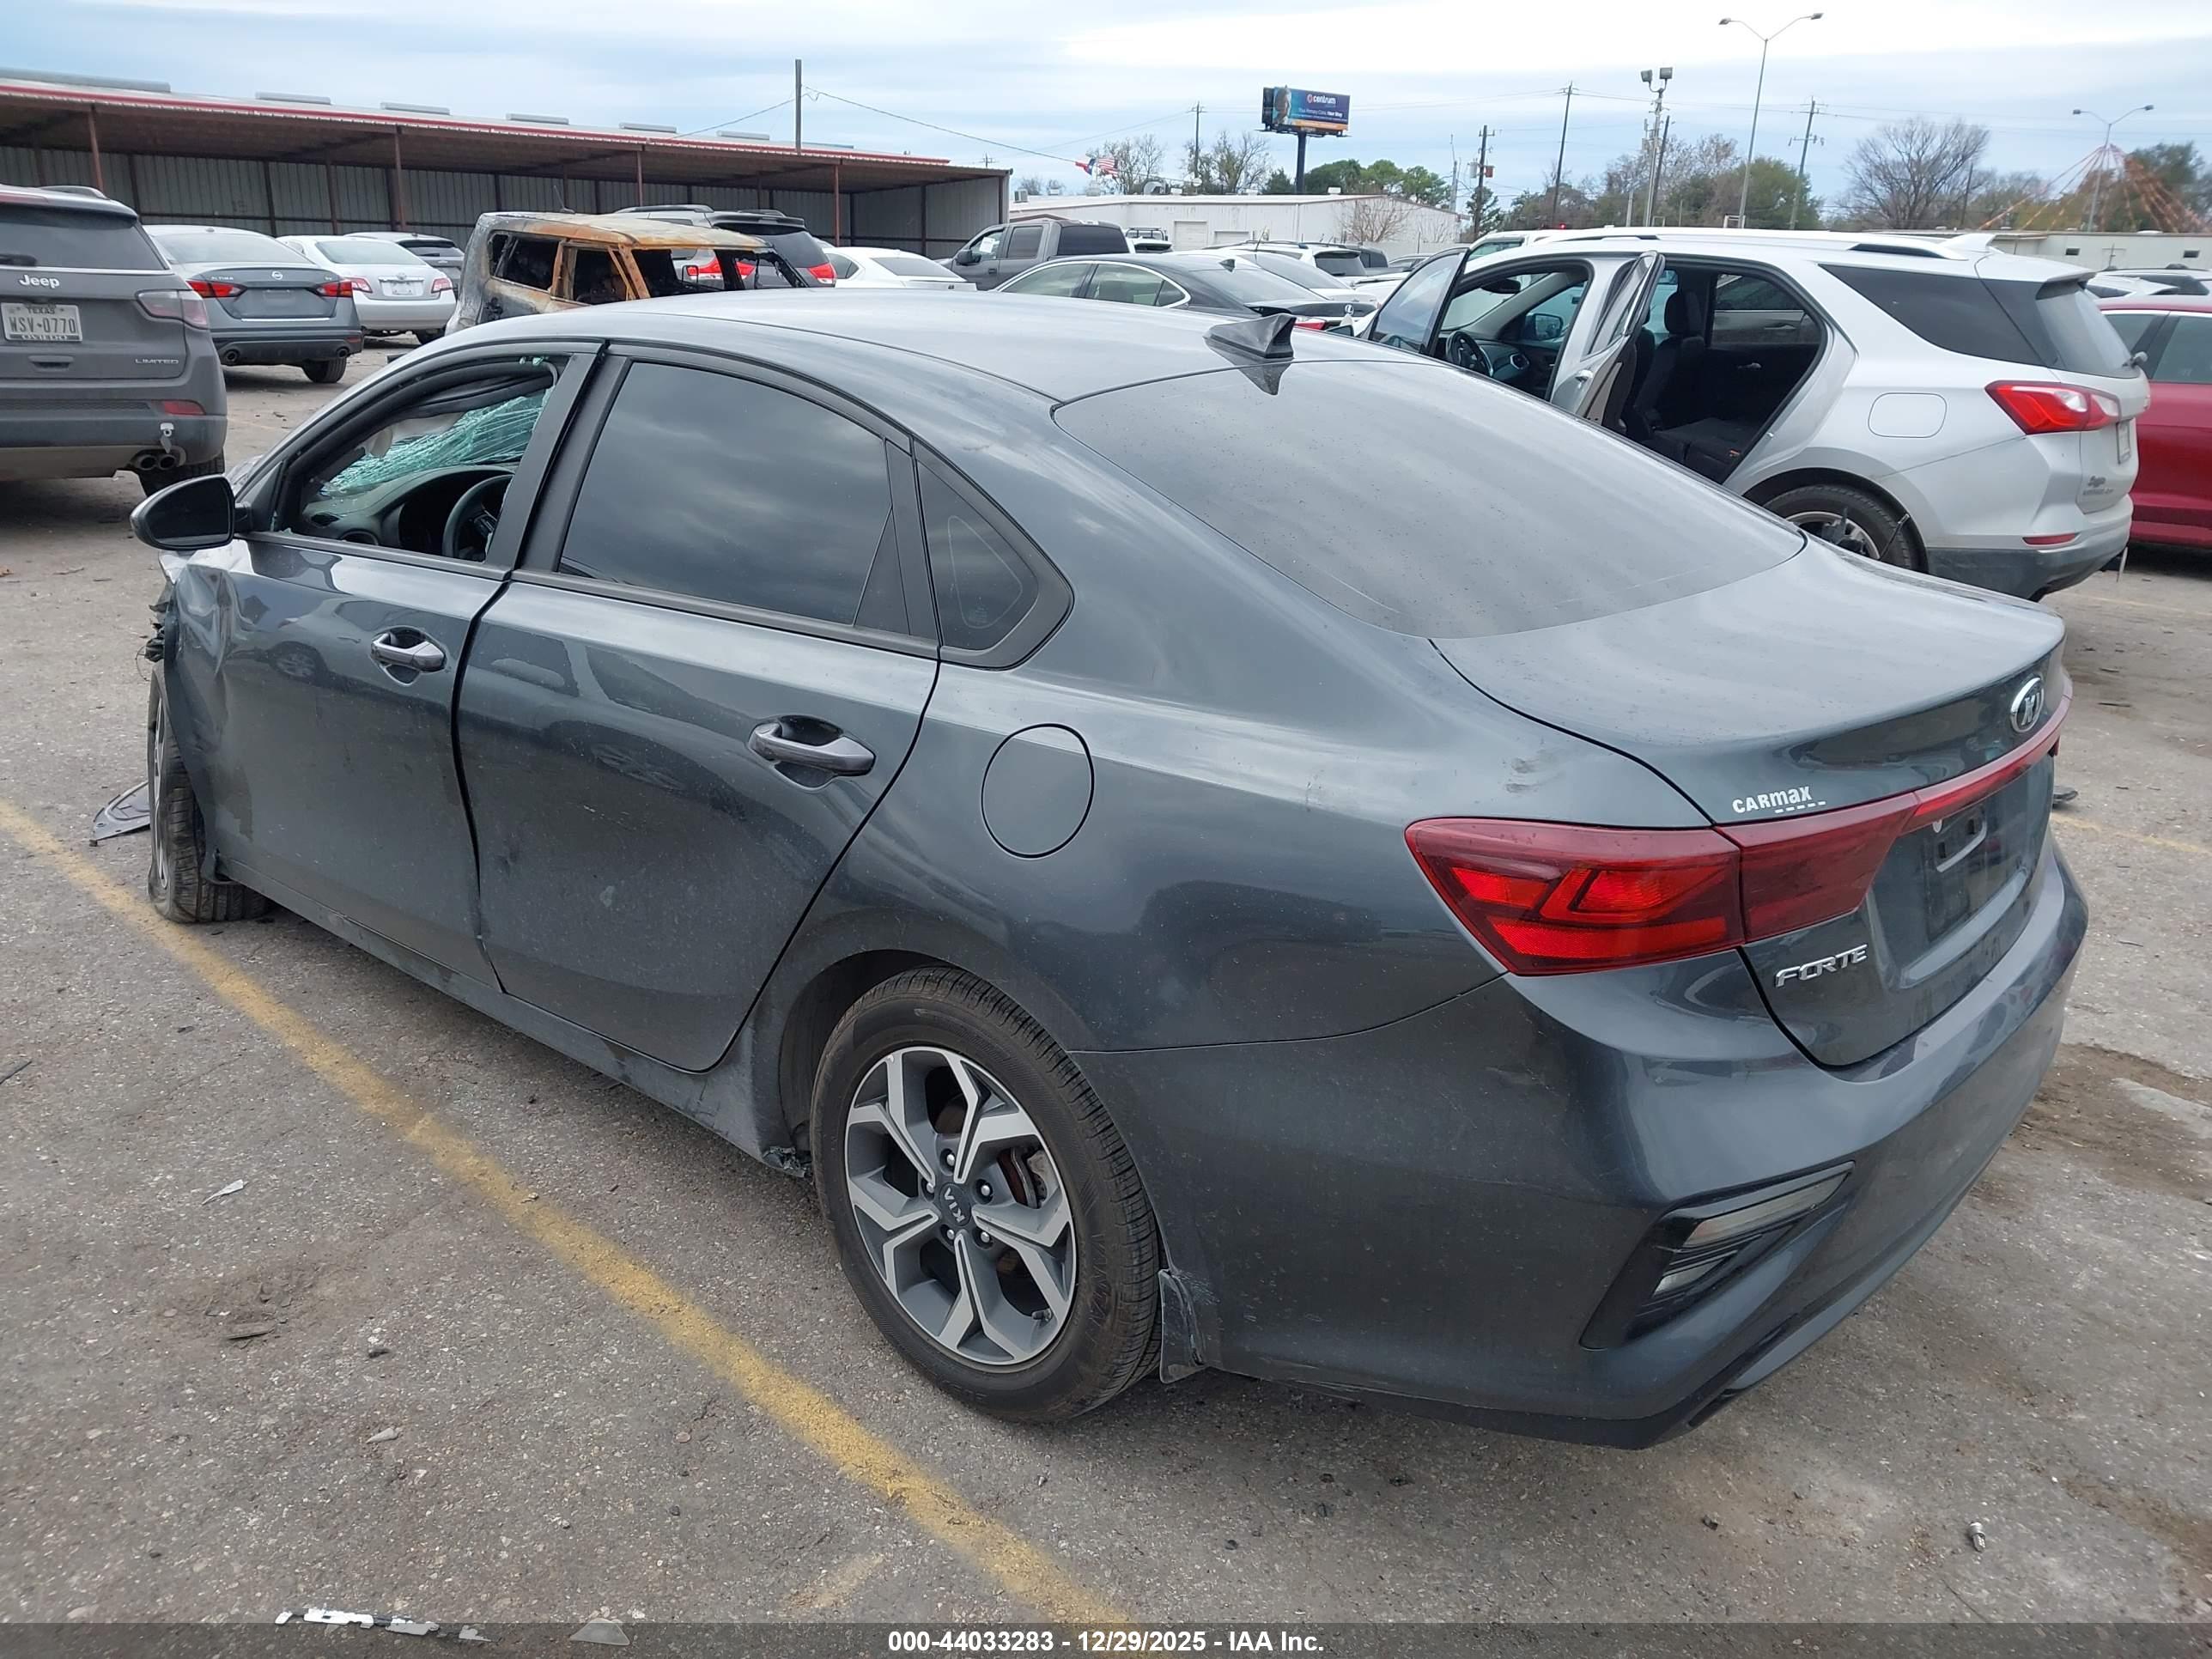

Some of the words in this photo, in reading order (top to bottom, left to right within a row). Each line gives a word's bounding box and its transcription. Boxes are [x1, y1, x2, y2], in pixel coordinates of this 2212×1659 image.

[1313, 95, 1336, 104] centrum
[19, 274, 60, 289] Jeep
[1775, 944, 1868, 988] FORTE
[944, 1187, 965, 1223] KIA
